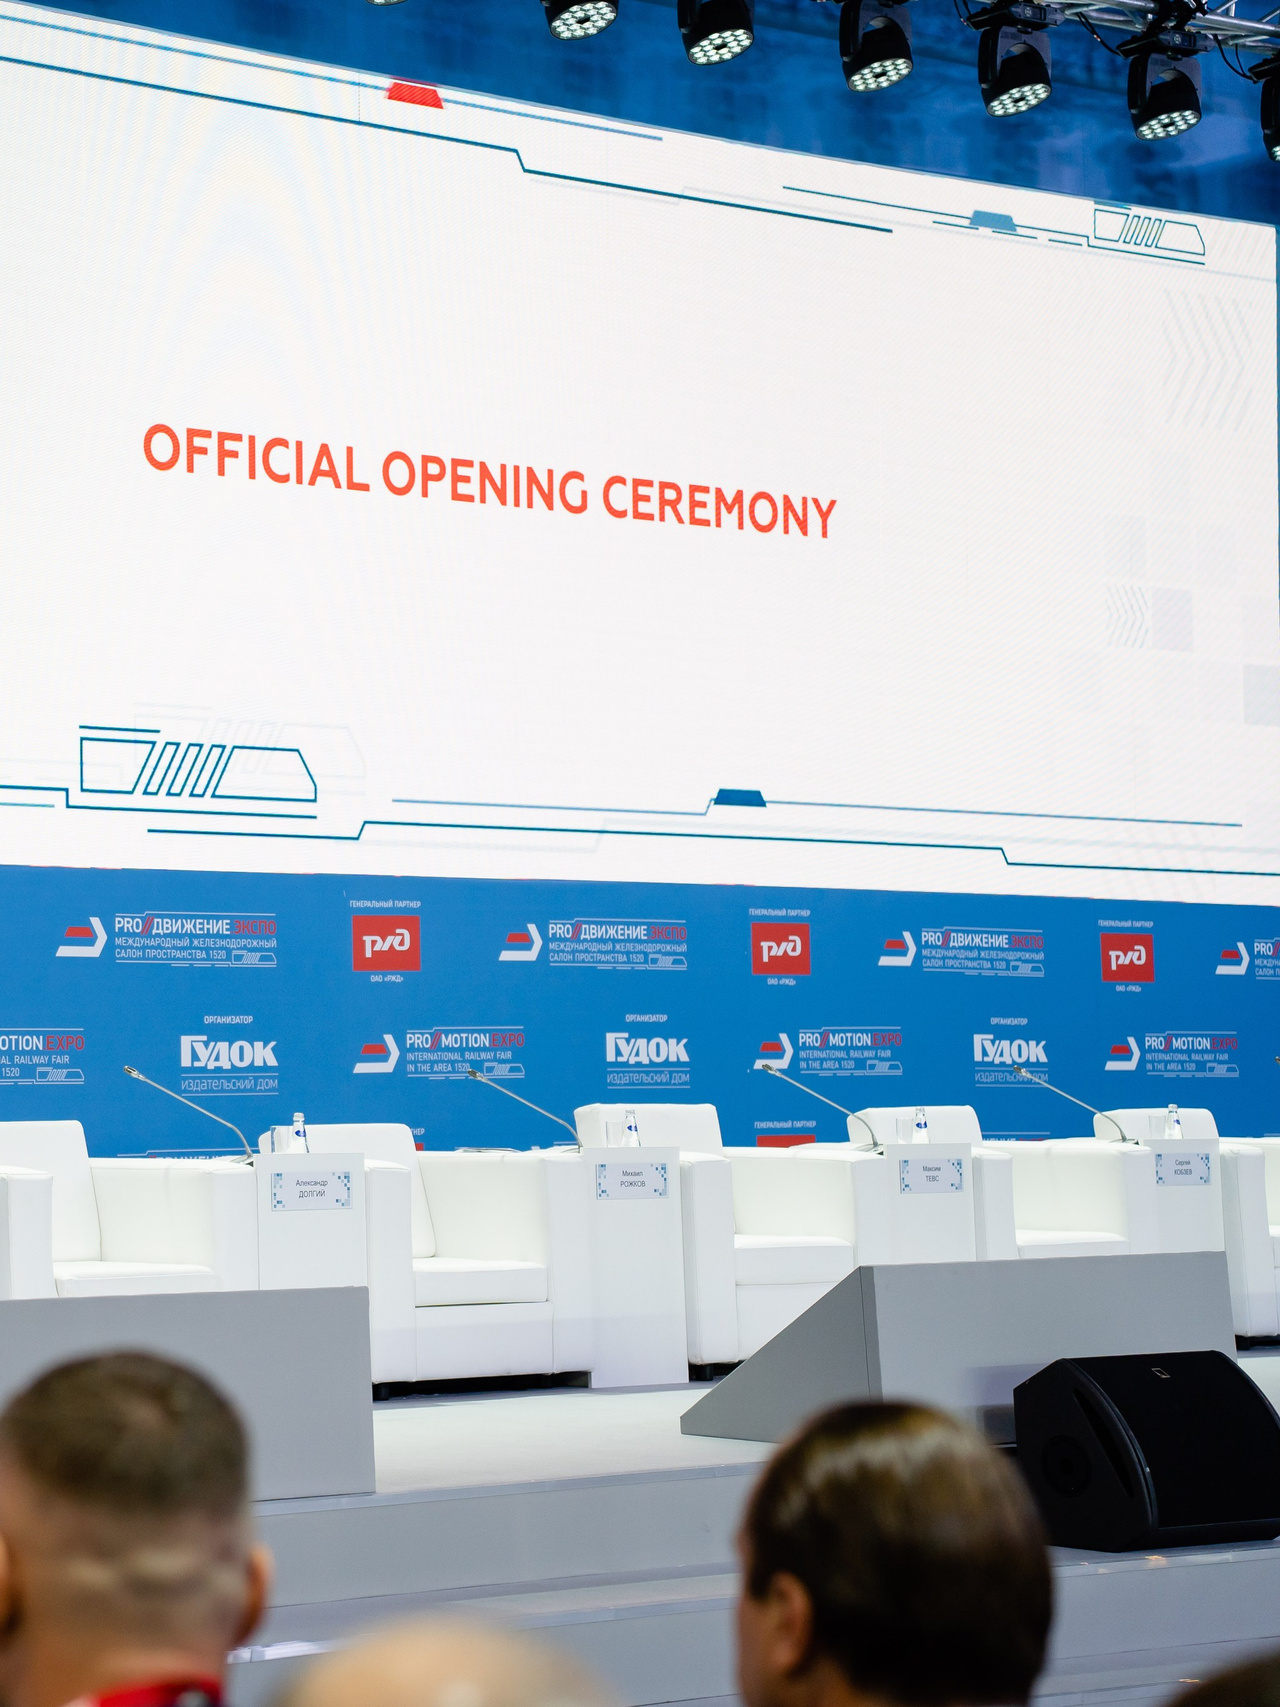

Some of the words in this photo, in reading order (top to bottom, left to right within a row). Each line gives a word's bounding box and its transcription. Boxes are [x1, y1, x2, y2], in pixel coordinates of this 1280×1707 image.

[143, 423, 370, 492] OFFICIAL
[381, 450, 588, 514] OPENING
[602, 475, 837, 539] CEREMONY
[114, 936, 189, 948] МЕЖДУНАРОДНЫЙ
[192, 937, 276, 948] ЖЕЛЕЗНОДОРОЖНЫЙ
[115, 948, 142, 958] САЛОН
[145, 948, 206, 958] ПРОСТРАНСТВА
[209, 949, 226, 959] 1520
[203, 1015, 253, 1023] ОРГАНИЗАТОР
[14, 1054, 48, 1064] RAILWAY
[51, 1054, 69, 1063] FAIR
[1, 1067, 19, 1076] 1520
[181, 1077, 254, 1091] издательский
[256, 1078, 277, 1090] дом
[620, 1180, 646, 1188] РОЖКОВ
[299, 1189, 325, 1198] ДОЛГИЙ
